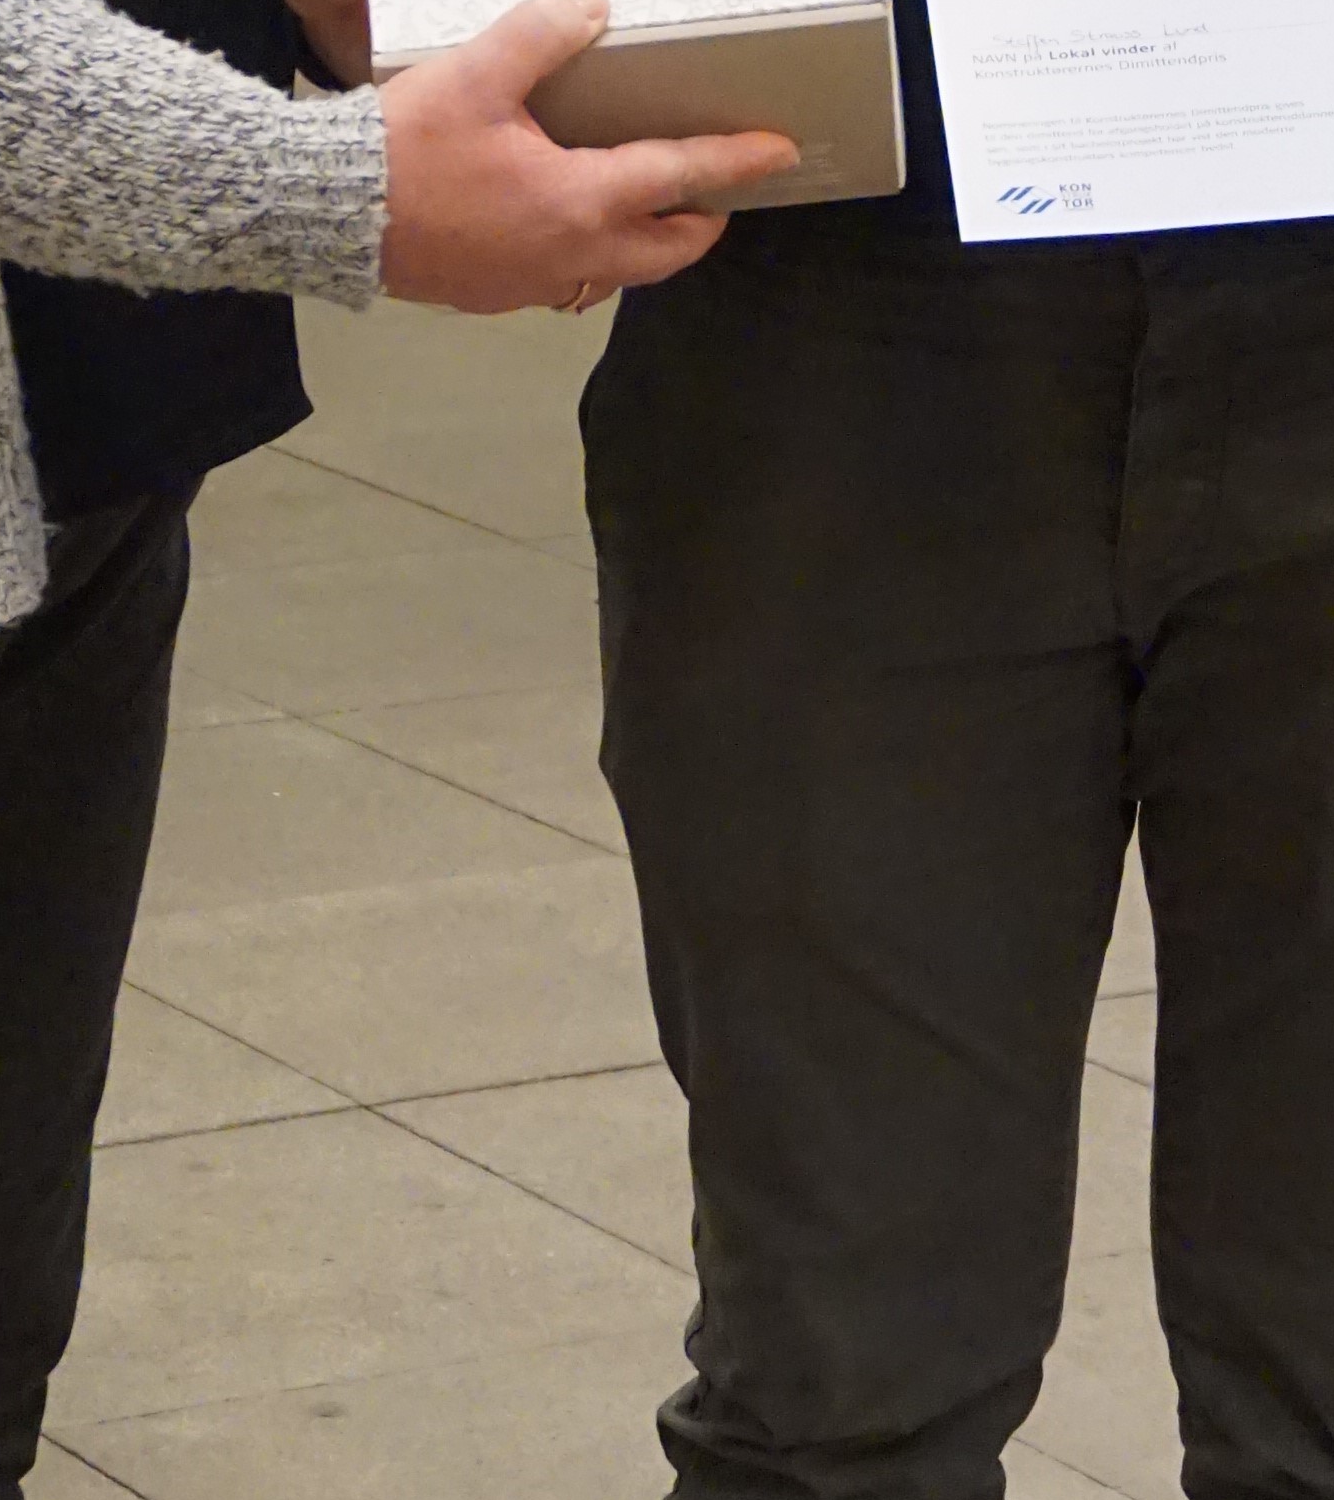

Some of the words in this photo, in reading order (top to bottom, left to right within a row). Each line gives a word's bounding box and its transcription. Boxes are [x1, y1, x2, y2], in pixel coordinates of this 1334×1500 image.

[971, 52, 1017, 65] NAVN
[1049, 46, 1095, 61] Lokal
[1101, 43, 1157, 57] vinder
[1118, 52, 1228, 72] Dimittendpris
[1058, 182, 1092, 193] KON
